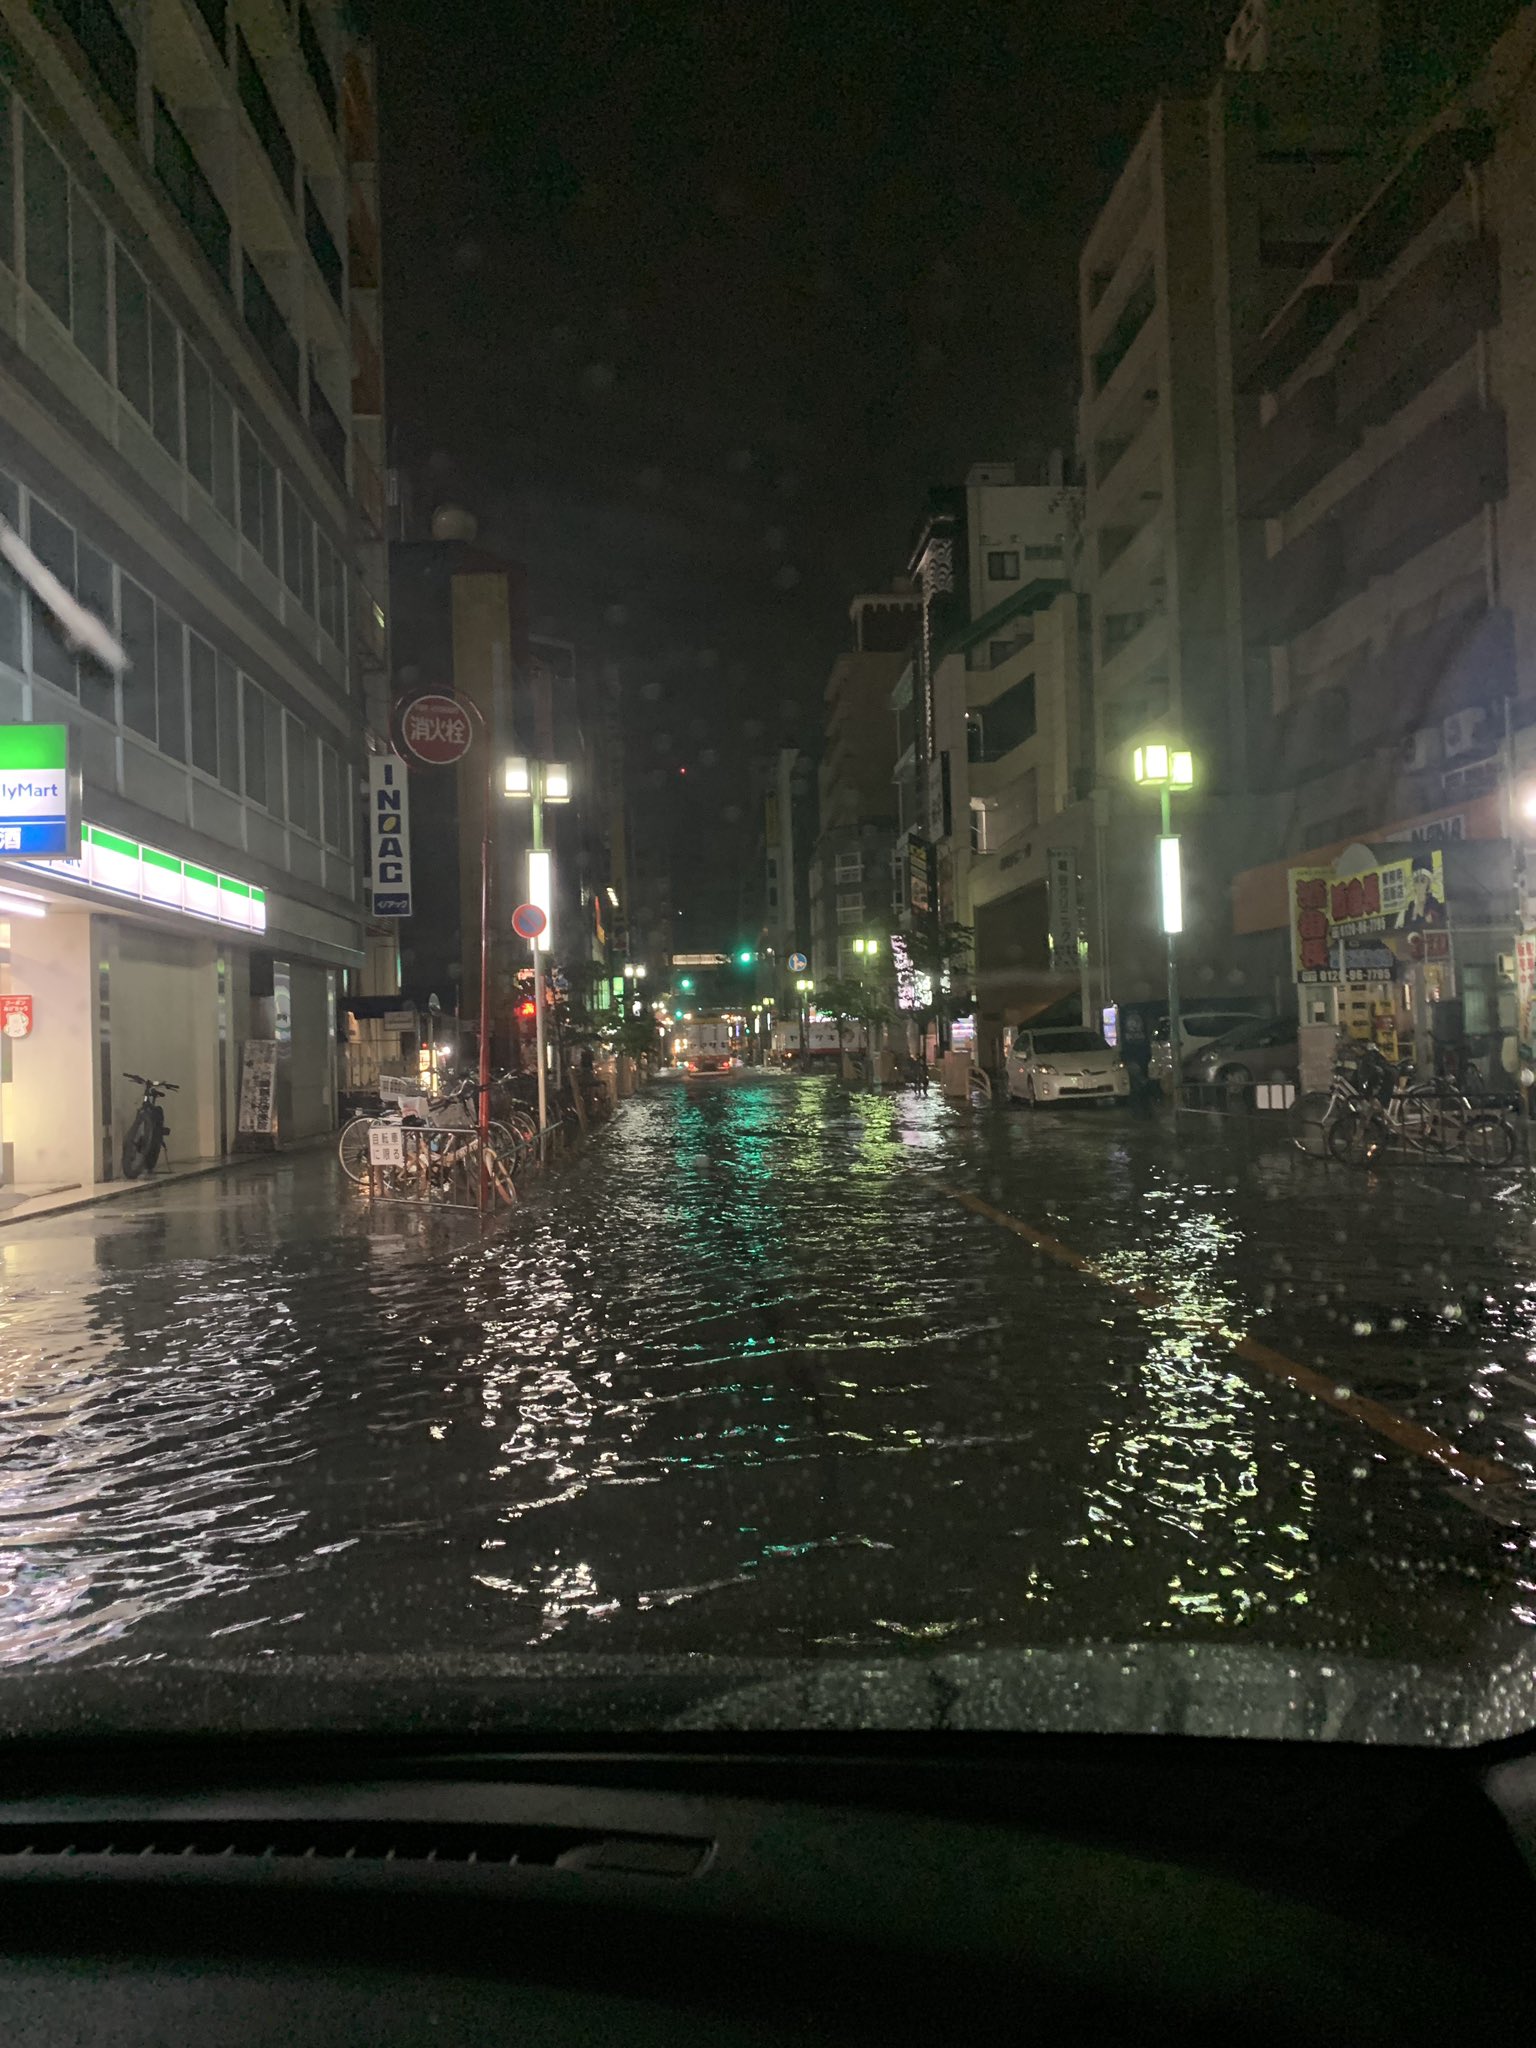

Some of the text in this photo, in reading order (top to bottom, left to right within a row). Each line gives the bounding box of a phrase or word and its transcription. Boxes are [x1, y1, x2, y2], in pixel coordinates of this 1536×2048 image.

[411, 716, 465, 744] 消火栓
[377, 764, 403, 883] INOAC
